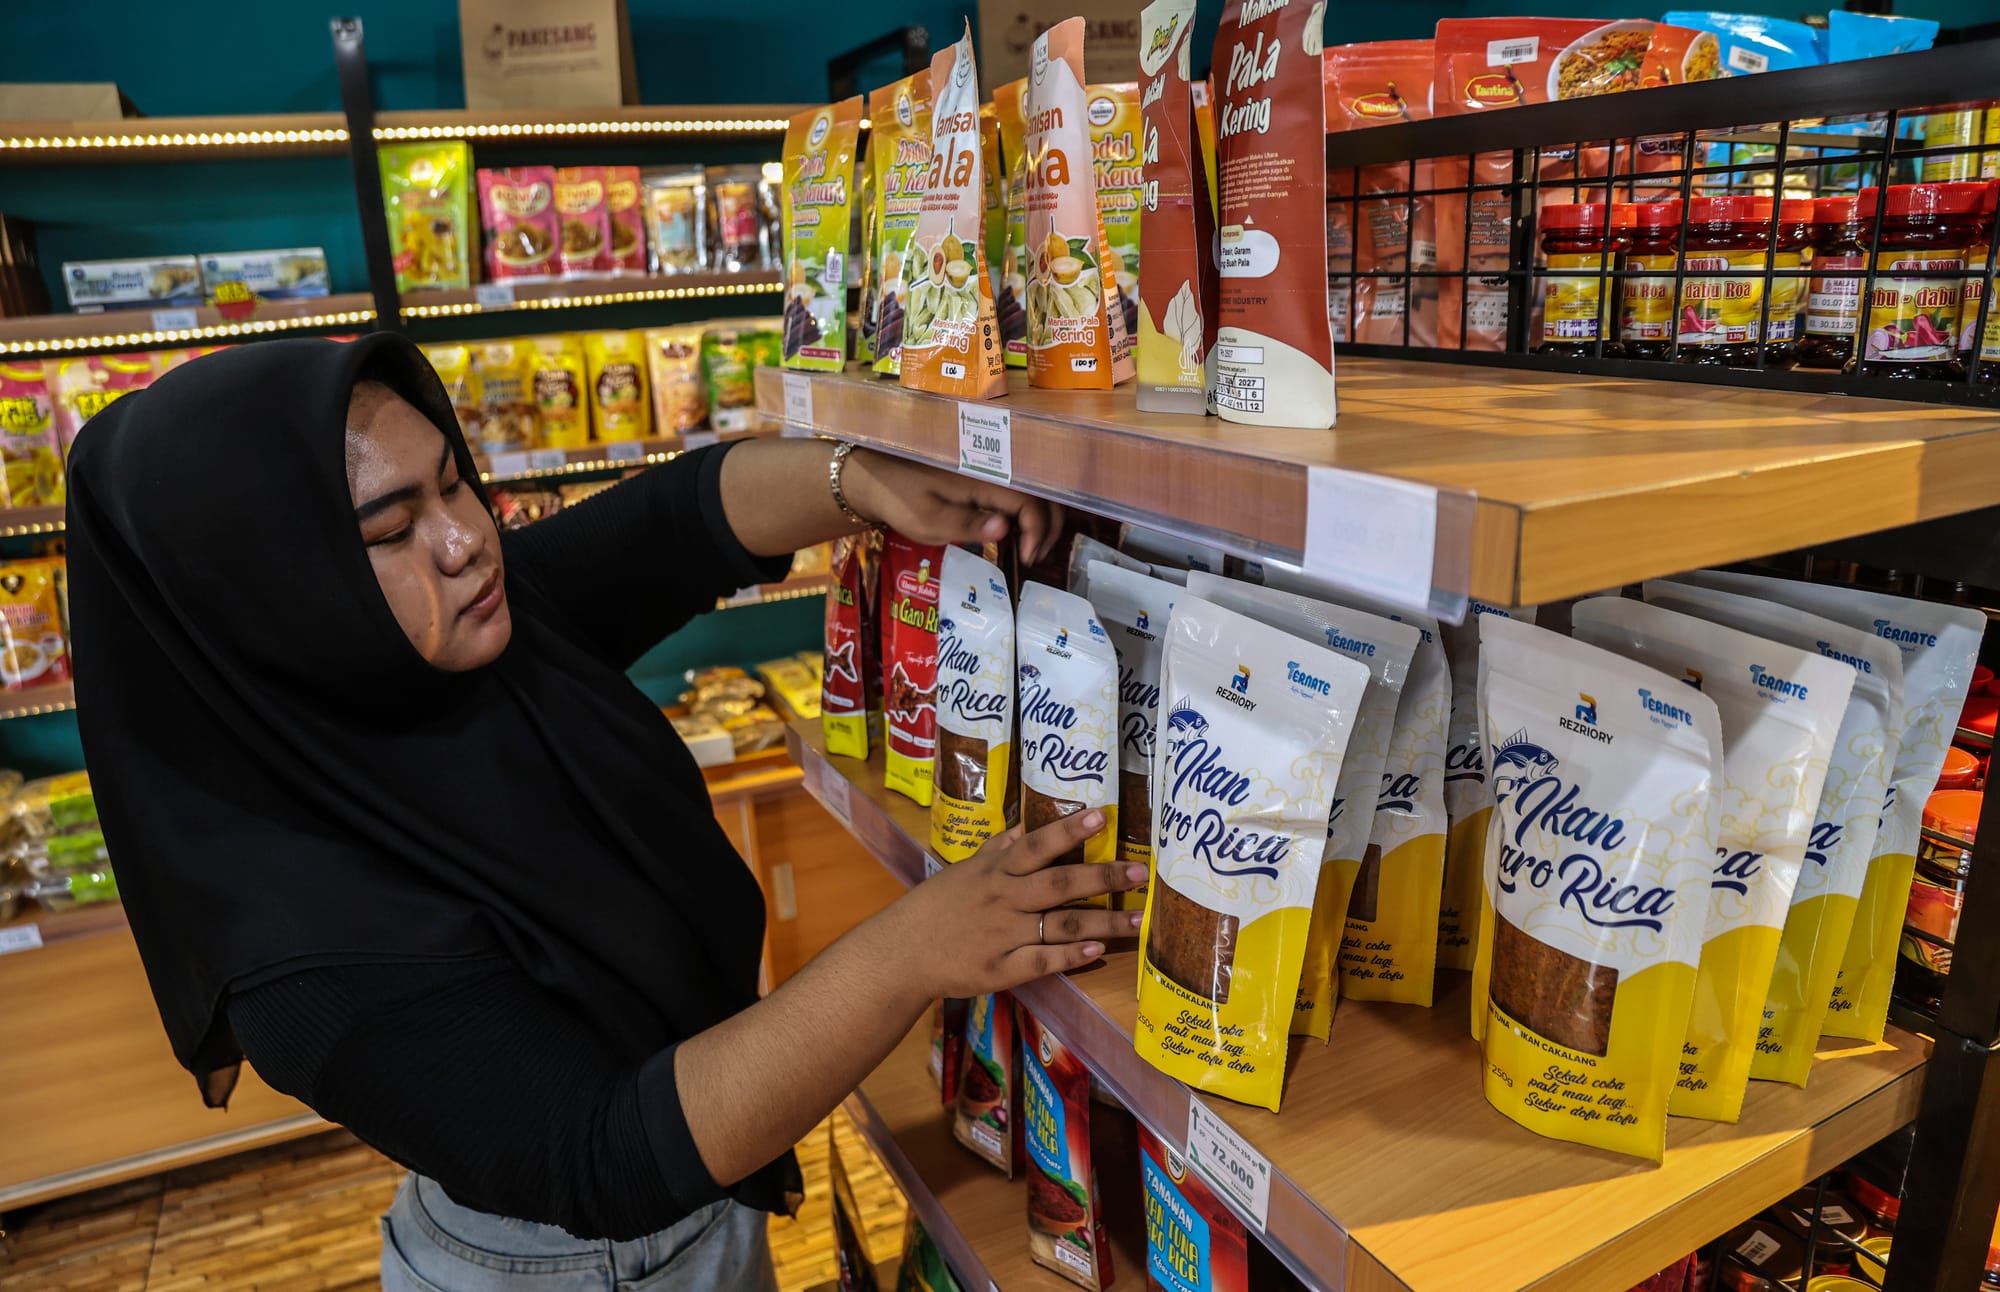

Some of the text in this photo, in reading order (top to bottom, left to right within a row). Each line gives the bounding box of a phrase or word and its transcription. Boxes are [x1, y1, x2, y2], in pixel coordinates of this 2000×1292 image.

[1475, 83, 1514, 97] Tantina
[1221, 97, 1272, 139] Kering
[1234, 247, 1251, 255] Garam
[1238, 258, 1250, 266] Pala
[1641, 283, 1666, 299] Roa
[1685, 281, 1751, 300] dabu Roa
[1916, 287, 1956, 307] dabu
[1048, 316, 1099, 326] Manisan Pala
[1052, 328, 1094, 345] Kering
[1178, 375, 1200, 383] HALAL
[973, 434, 1000, 453] 25.000
[900, 598, 925, 628] Garo
[1126, 626, 1157, 642] REZRIORY
[1325, 628, 1376, 656] TERNATE
[1873, 619, 1937, 648] TERNATE
[1046, 646, 1072, 660] REZRIORY
[1287, 660, 1331, 697] TERNATE
[1749, 663, 1808, 701] TERNATE
[952, 679, 1007, 722] Rica
[1216, 686, 1257, 712] REZRIORY
[1638, 688, 1693, 726] TERNATE
[1560, 717, 1613, 745] REZRIORY
[1039, 734, 1109, 784] Rica
[1172, 739, 1250, 804] Ikan
[1515, 777, 1626, 851] Ikan
[1193, 809, 1290, 881] Rica
[1558, 853, 1677, 933] Rica
[1342, 954, 1368, 963] mau
[1365, 941, 1392, 951] coba
[1350, 967, 1404, 981] dofu dofu
[1159, 979, 1220, 1013] IKAN CAKALANG
[1176, 1009, 1212, 1030] Sekali
[1164, 1023, 1189, 1039] pasti
[1191, 1035, 1216, 1048] mau
[1494, 1012, 1597, 1067] TUNA IKAN CAKALANG
[1161, 1036, 1256, 1074] Sukur dofu dofu
[1491, 1066, 1513, 1088] 250g
[1528, 1077, 1558, 1094] pasti
[1562, 1089, 1593, 1102] mau
[1543, 1065, 1625, 1090] Sekali coba
[1677, 1078, 1709, 1091] dofu
[1524, 1092, 1639, 1126] Sukur dofu dofu
[1211, 1140, 1254, 1190] 72.000
[1241, 1148, 1252, 1162] 250
[1146, 1167, 1192, 1233] TANAWAN
[1169, 1215, 1199, 1265] TUNA
[1153, 1251, 1168, 1277] Khas
[1168, 1246, 1200, 1286] RICA
